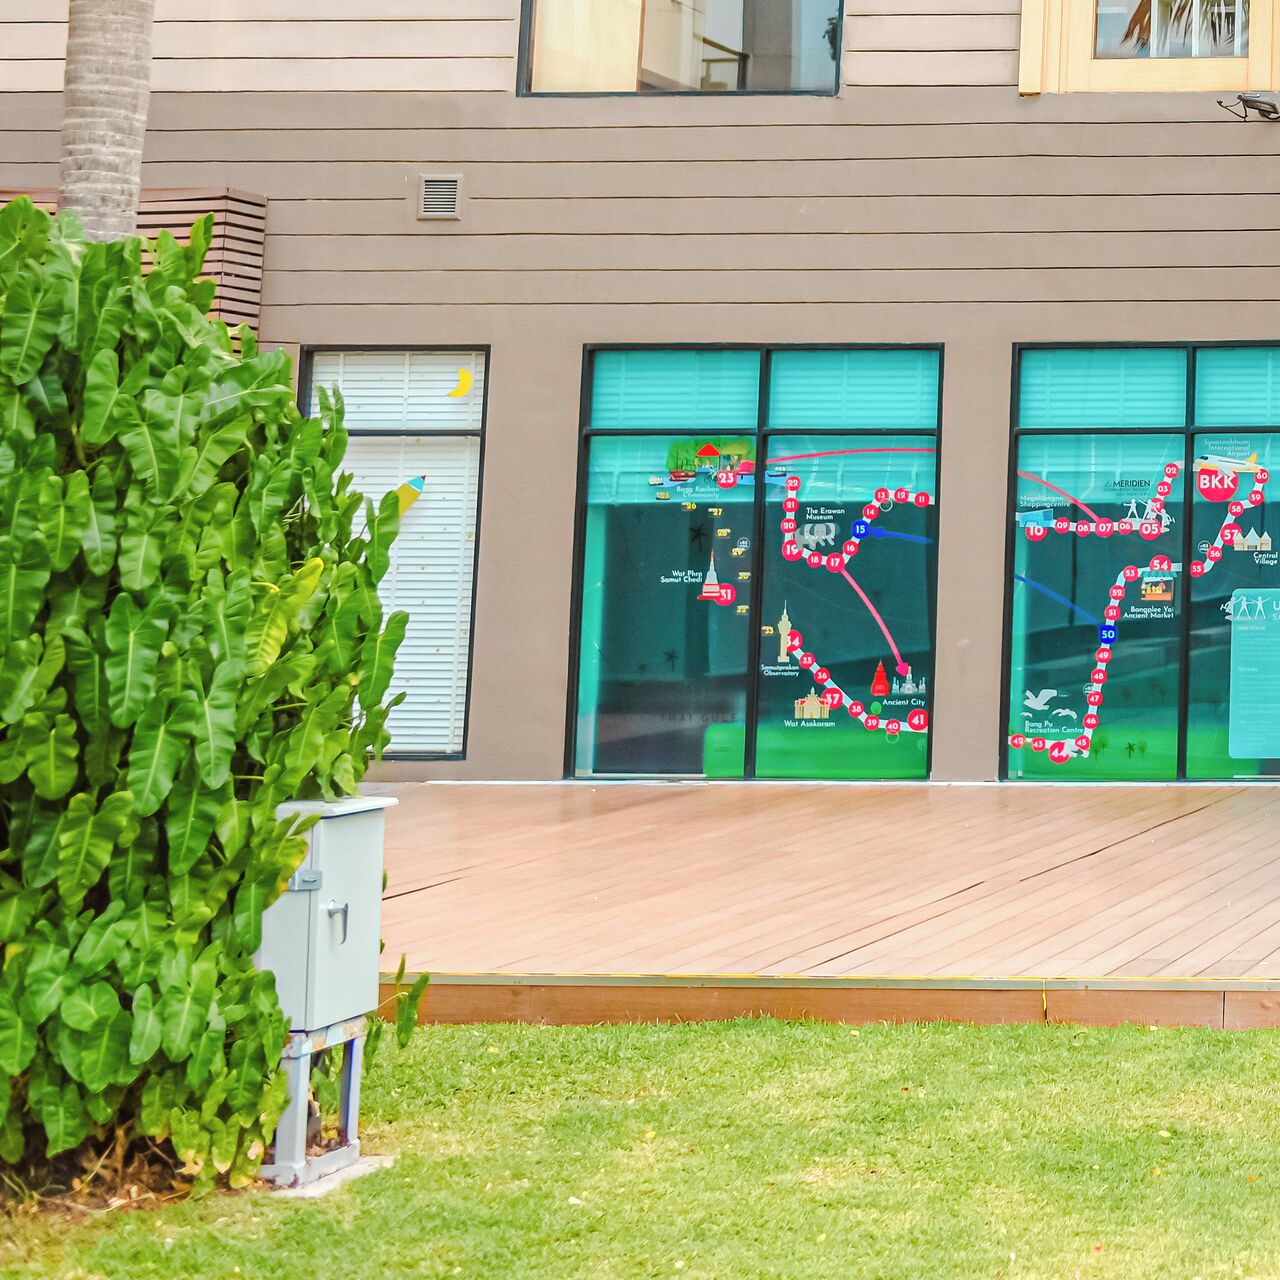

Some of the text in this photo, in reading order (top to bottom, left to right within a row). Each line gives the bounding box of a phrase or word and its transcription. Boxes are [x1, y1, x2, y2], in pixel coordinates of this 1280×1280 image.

[719, 473, 735, 484] 23
[1200, 475, 1235, 489] BKK
[1157, 485, 1168, 493] 03
[877, 491, 886, 499] 13
[897, 491, 906, 499] 12
[866, 508, 875, 516] 14
[783, 522, 794, 530] 20
[856, 525, 866, 534] 15
[1099, 523, 1113, 532] 07
[1142, 523, 1159, 535] 05
[1030, 527, 1044, 536] 10
[1224, 530, 1239, 539] 57
[830, 557, 840, 567] 17
[1153, 560, 1168, 570] 54
[1254, 558, 1278, 566] Village
[720, 589, 731, 600] 31
[1102, 630, 1115, 639] 50
[786, 637, 800, 647] 34
[803, 656, 812, 664] 35
[826, 693, 840, 705] 37
[882, 698, 926, 707] Ancient City
[851, 705, 862, 713] 38
[911, 714, 924, 725] 41
[887, 722, 899, 730] 40
